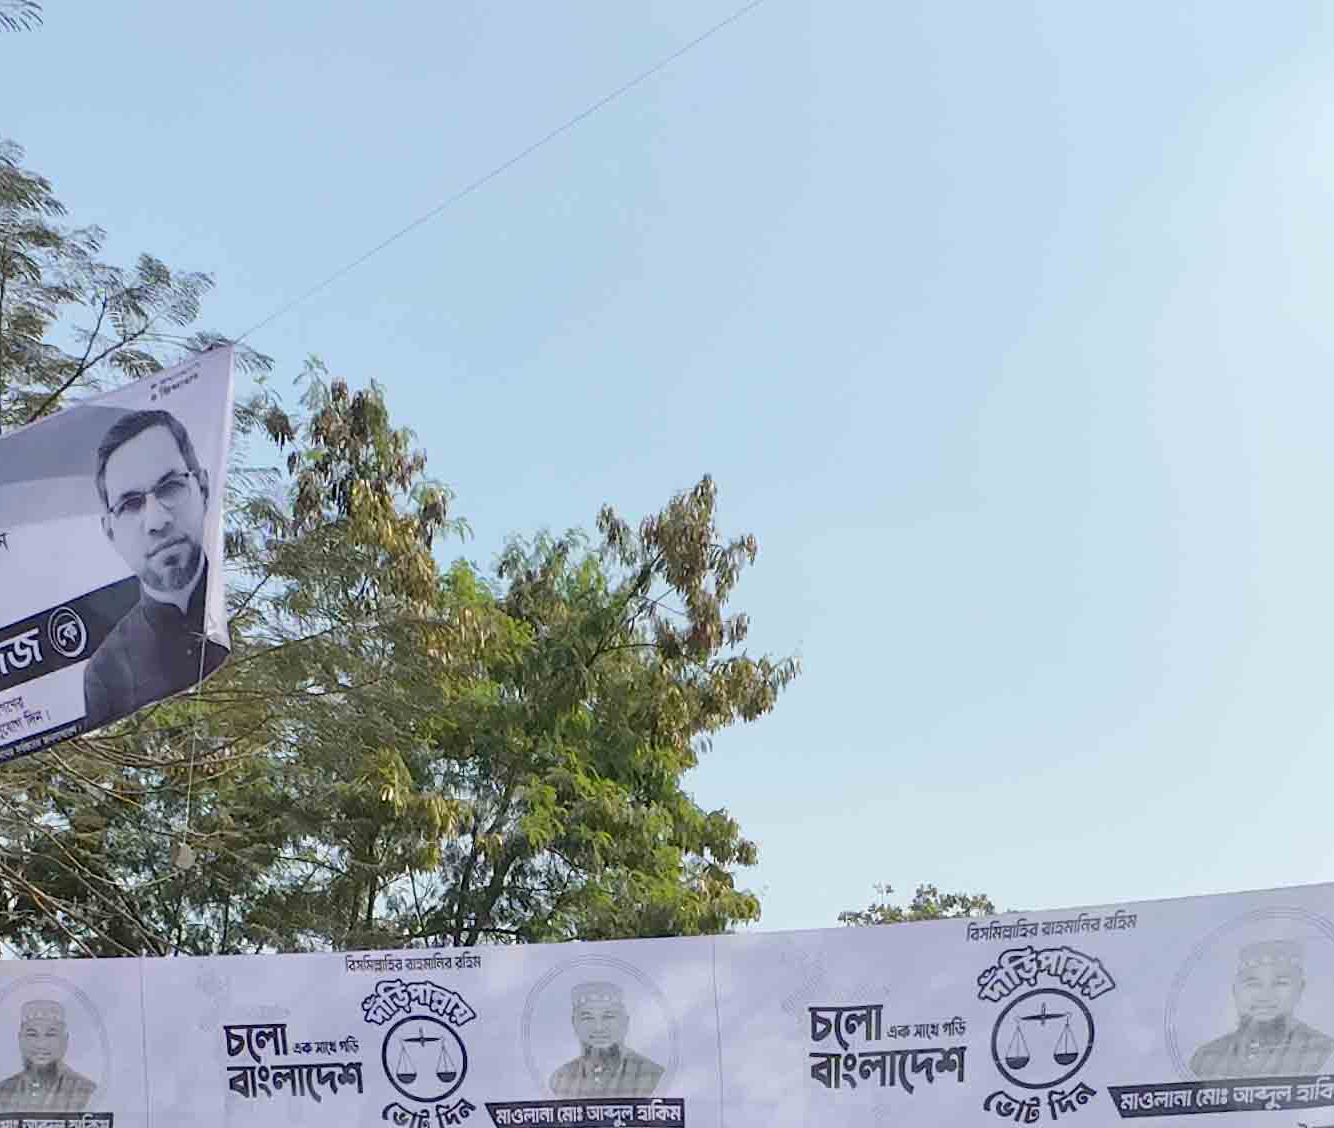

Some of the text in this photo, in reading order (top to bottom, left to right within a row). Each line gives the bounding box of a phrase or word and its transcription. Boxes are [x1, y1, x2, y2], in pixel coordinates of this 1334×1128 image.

[977, 945, 1116, 1003] দাঁড়িপাল্লায়
[223, 1024, 288, 1063] চলো
[292, 1042, 312, 1054] এক
[808, 1004, 884, 1051] চলো
[887, 1024, 911, 1039] এক
[913, 1023, 939, 1040] সাথে
[227, 1062, 363, 1103] বাংলাদেশ
[809, 1046, 967, 1095] বাংলাদেশ
[496, 1099, 682, 1128] মাওলানা মোঃ আব্দুল হাকিম
[983, 1081, 1097, 1124] ভোট দিন
[1120, 1090, 1192, 1111] মাওলানা
[1196, 1088, 1228, 1107] মোঃ
[1233, 1085, 1292, 1110] আব্দুল
